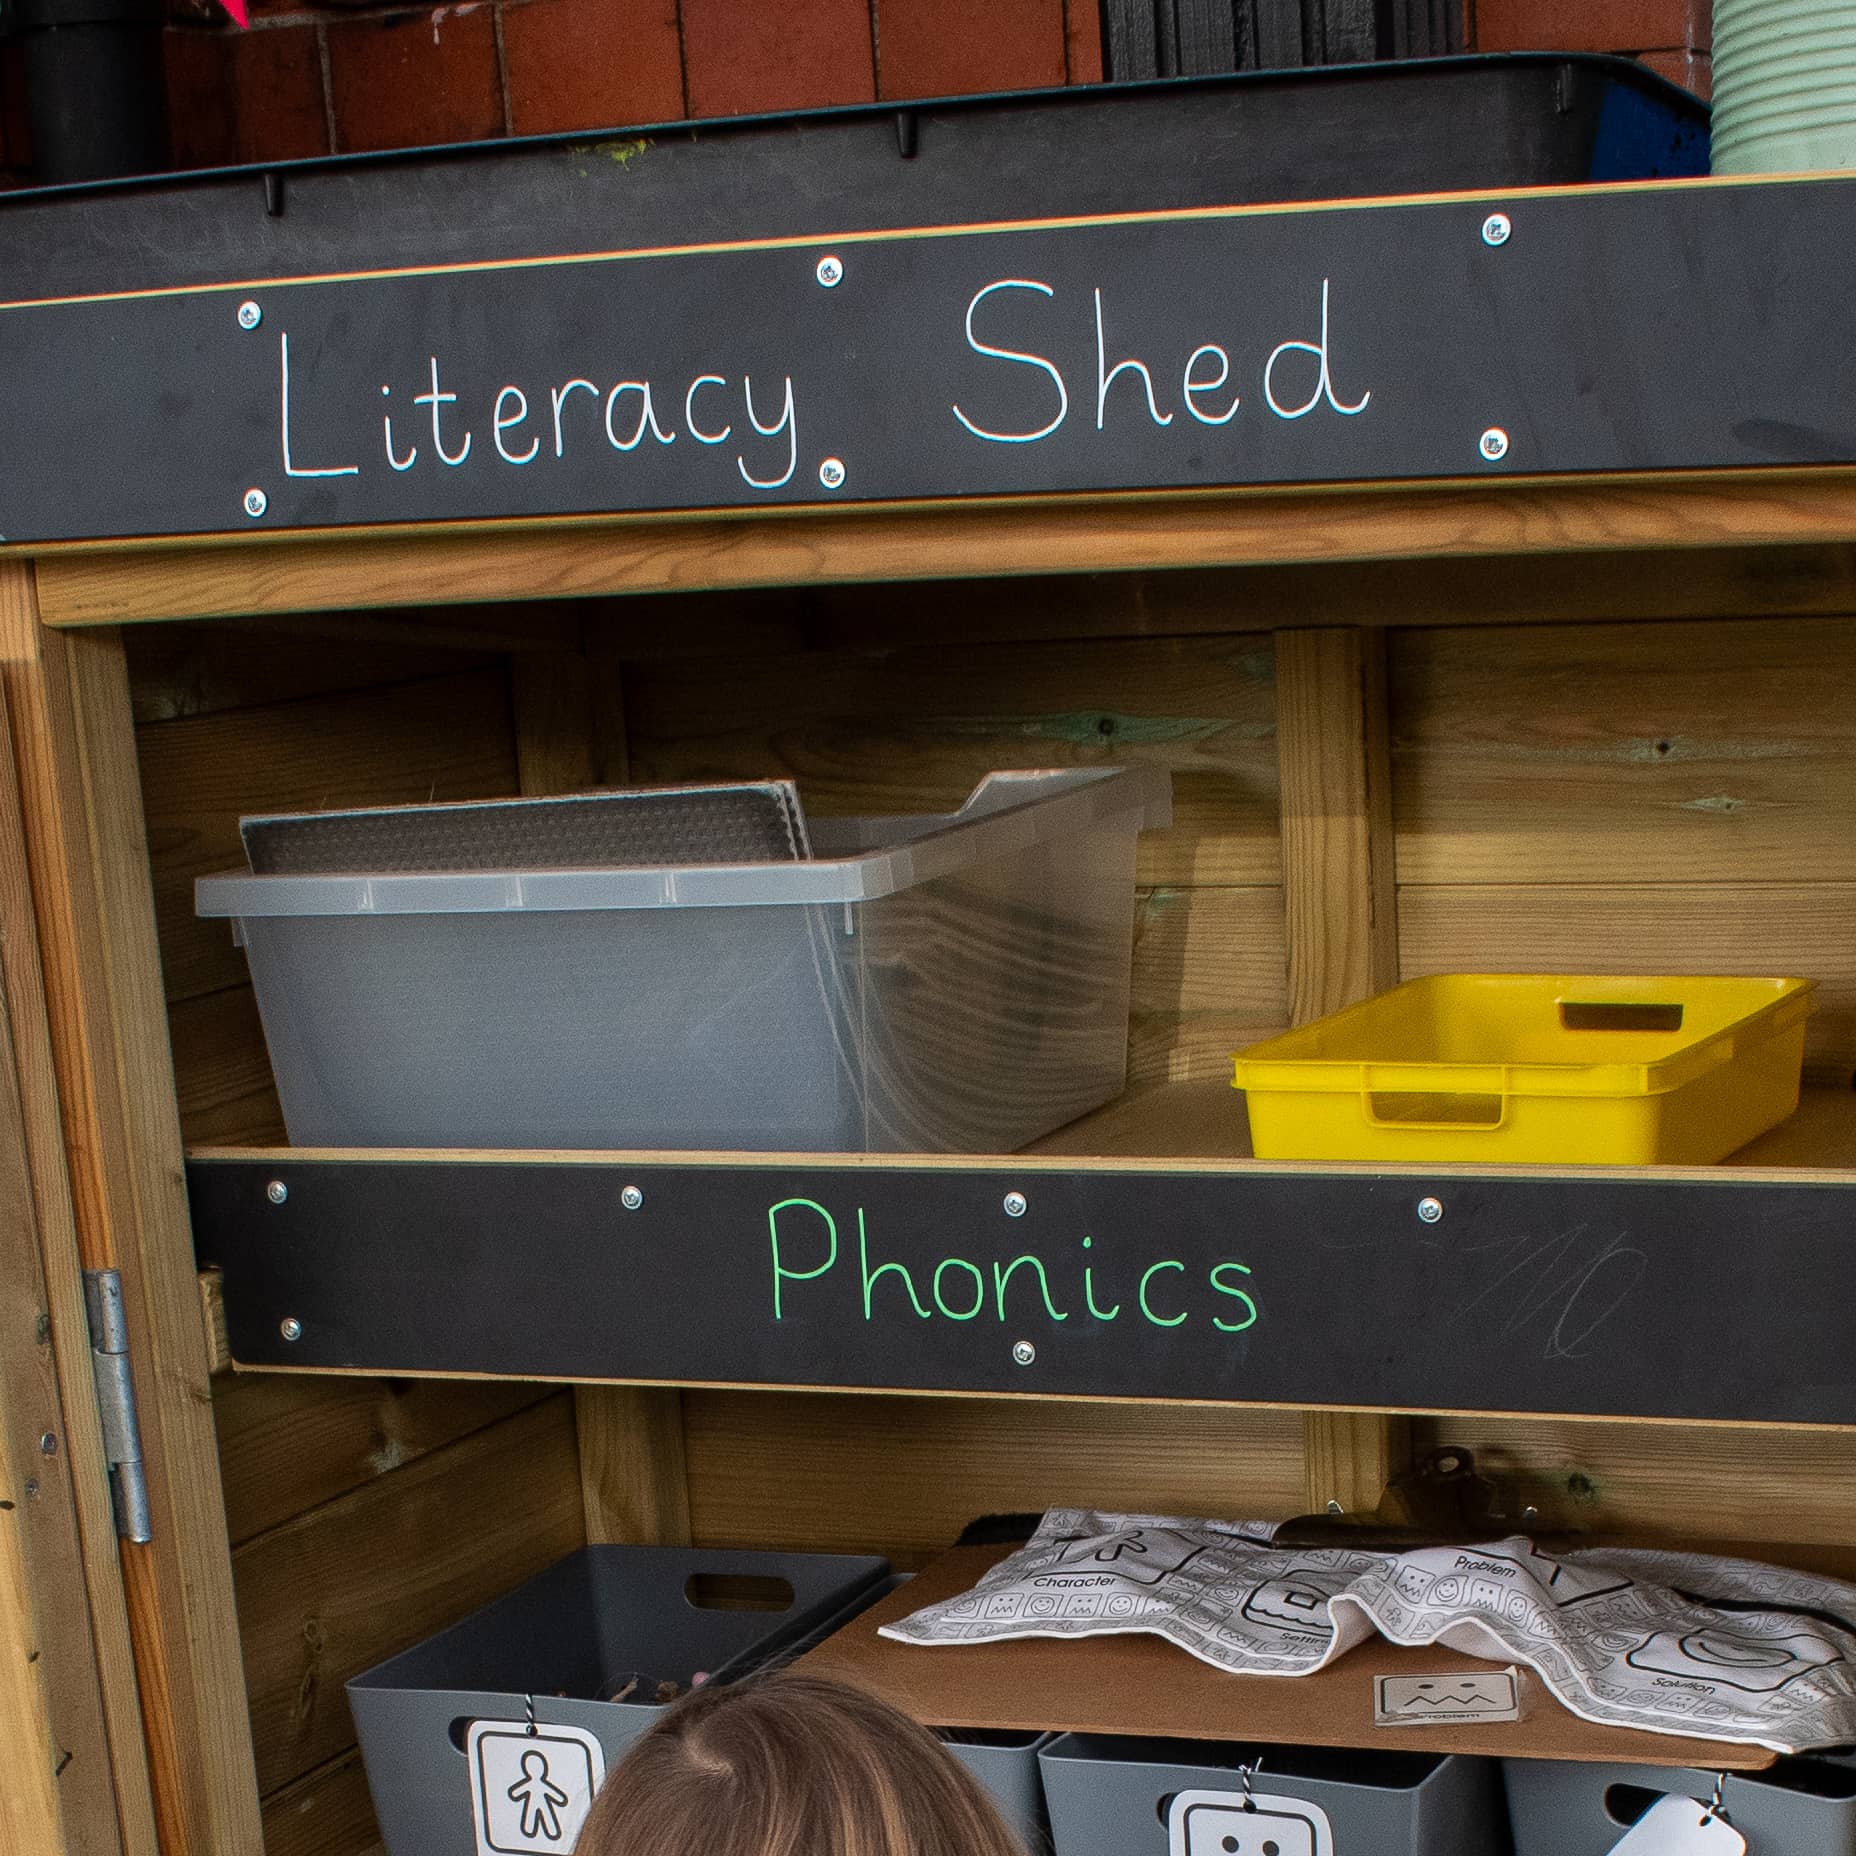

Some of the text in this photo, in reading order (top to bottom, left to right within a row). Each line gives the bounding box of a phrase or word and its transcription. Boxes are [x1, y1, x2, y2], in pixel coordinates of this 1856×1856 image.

[274, 277, 1373, 492] Literacy Shed
[767, 1197, 1259, 1334] Phonics
[1453, 1554, 1518, 1579] Problem
[1033, 1574, 1117, 1589] Character
[1651, 1676, 1716, 1696] Solution
